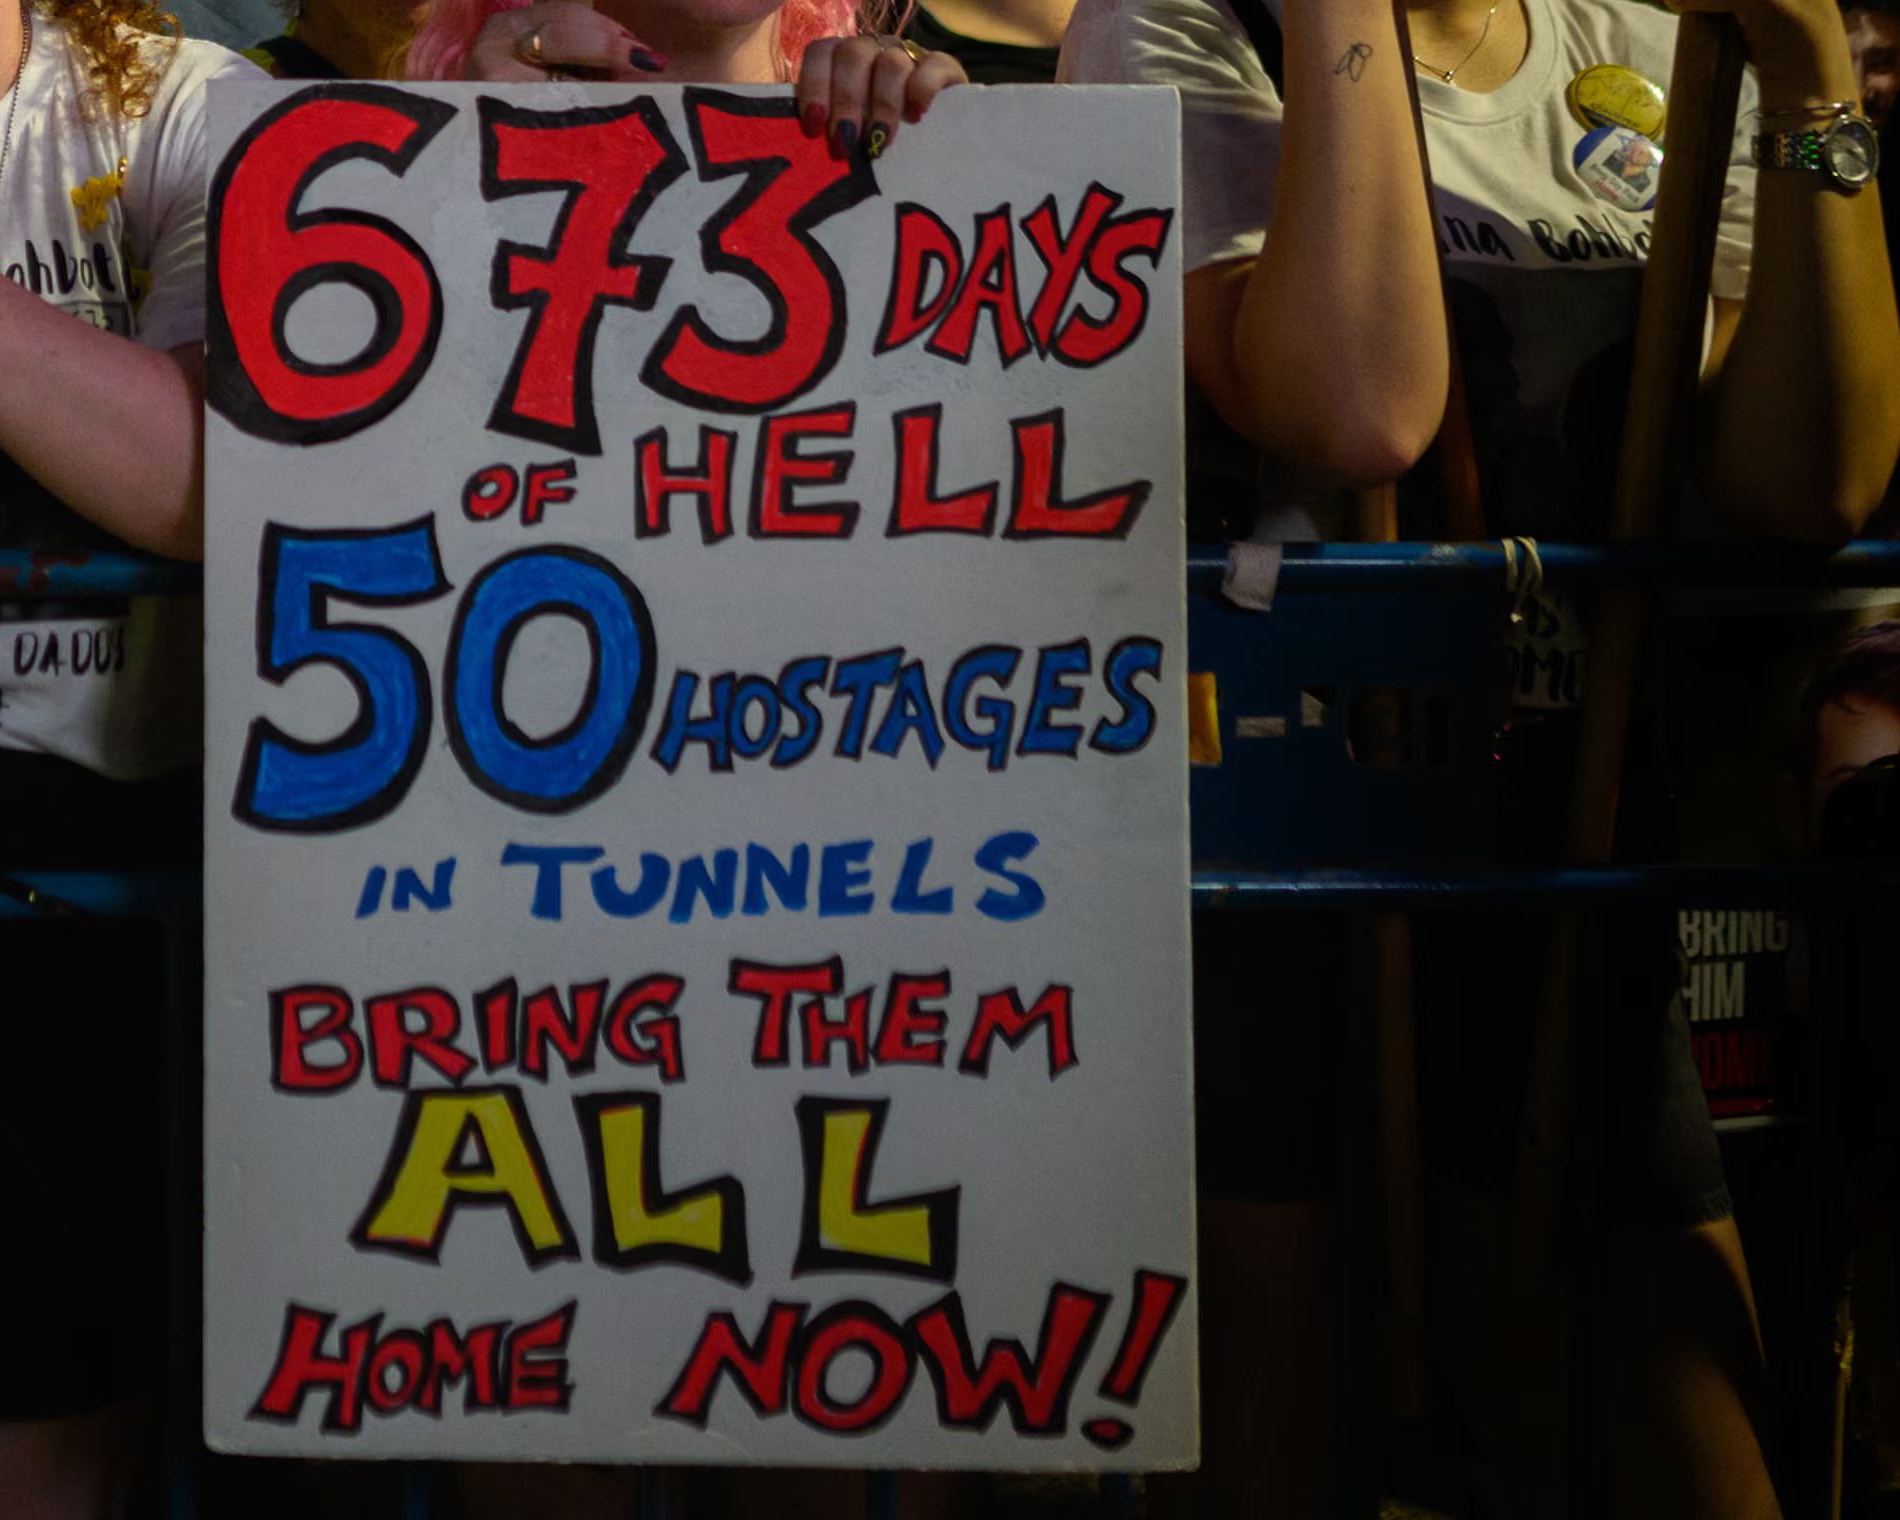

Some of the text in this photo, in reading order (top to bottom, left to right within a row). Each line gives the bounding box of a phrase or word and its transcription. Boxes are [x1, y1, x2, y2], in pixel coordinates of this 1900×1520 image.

[204, 83, 1174, 456] 673 DAYS
[462, 399, 1153, 543] OF HELL
[231, 512, 1165, 835] 50 HOSTAGES
[354, 829, 1047, 924] IN TUNNELS
[1677, 909, 1792, 958] BRING
[268, 955, 1080, 1095] BRING THEM
[348, 1085, 962, 1288] ALL
[245, 1268, 1188, 1450] HOME NOW!
